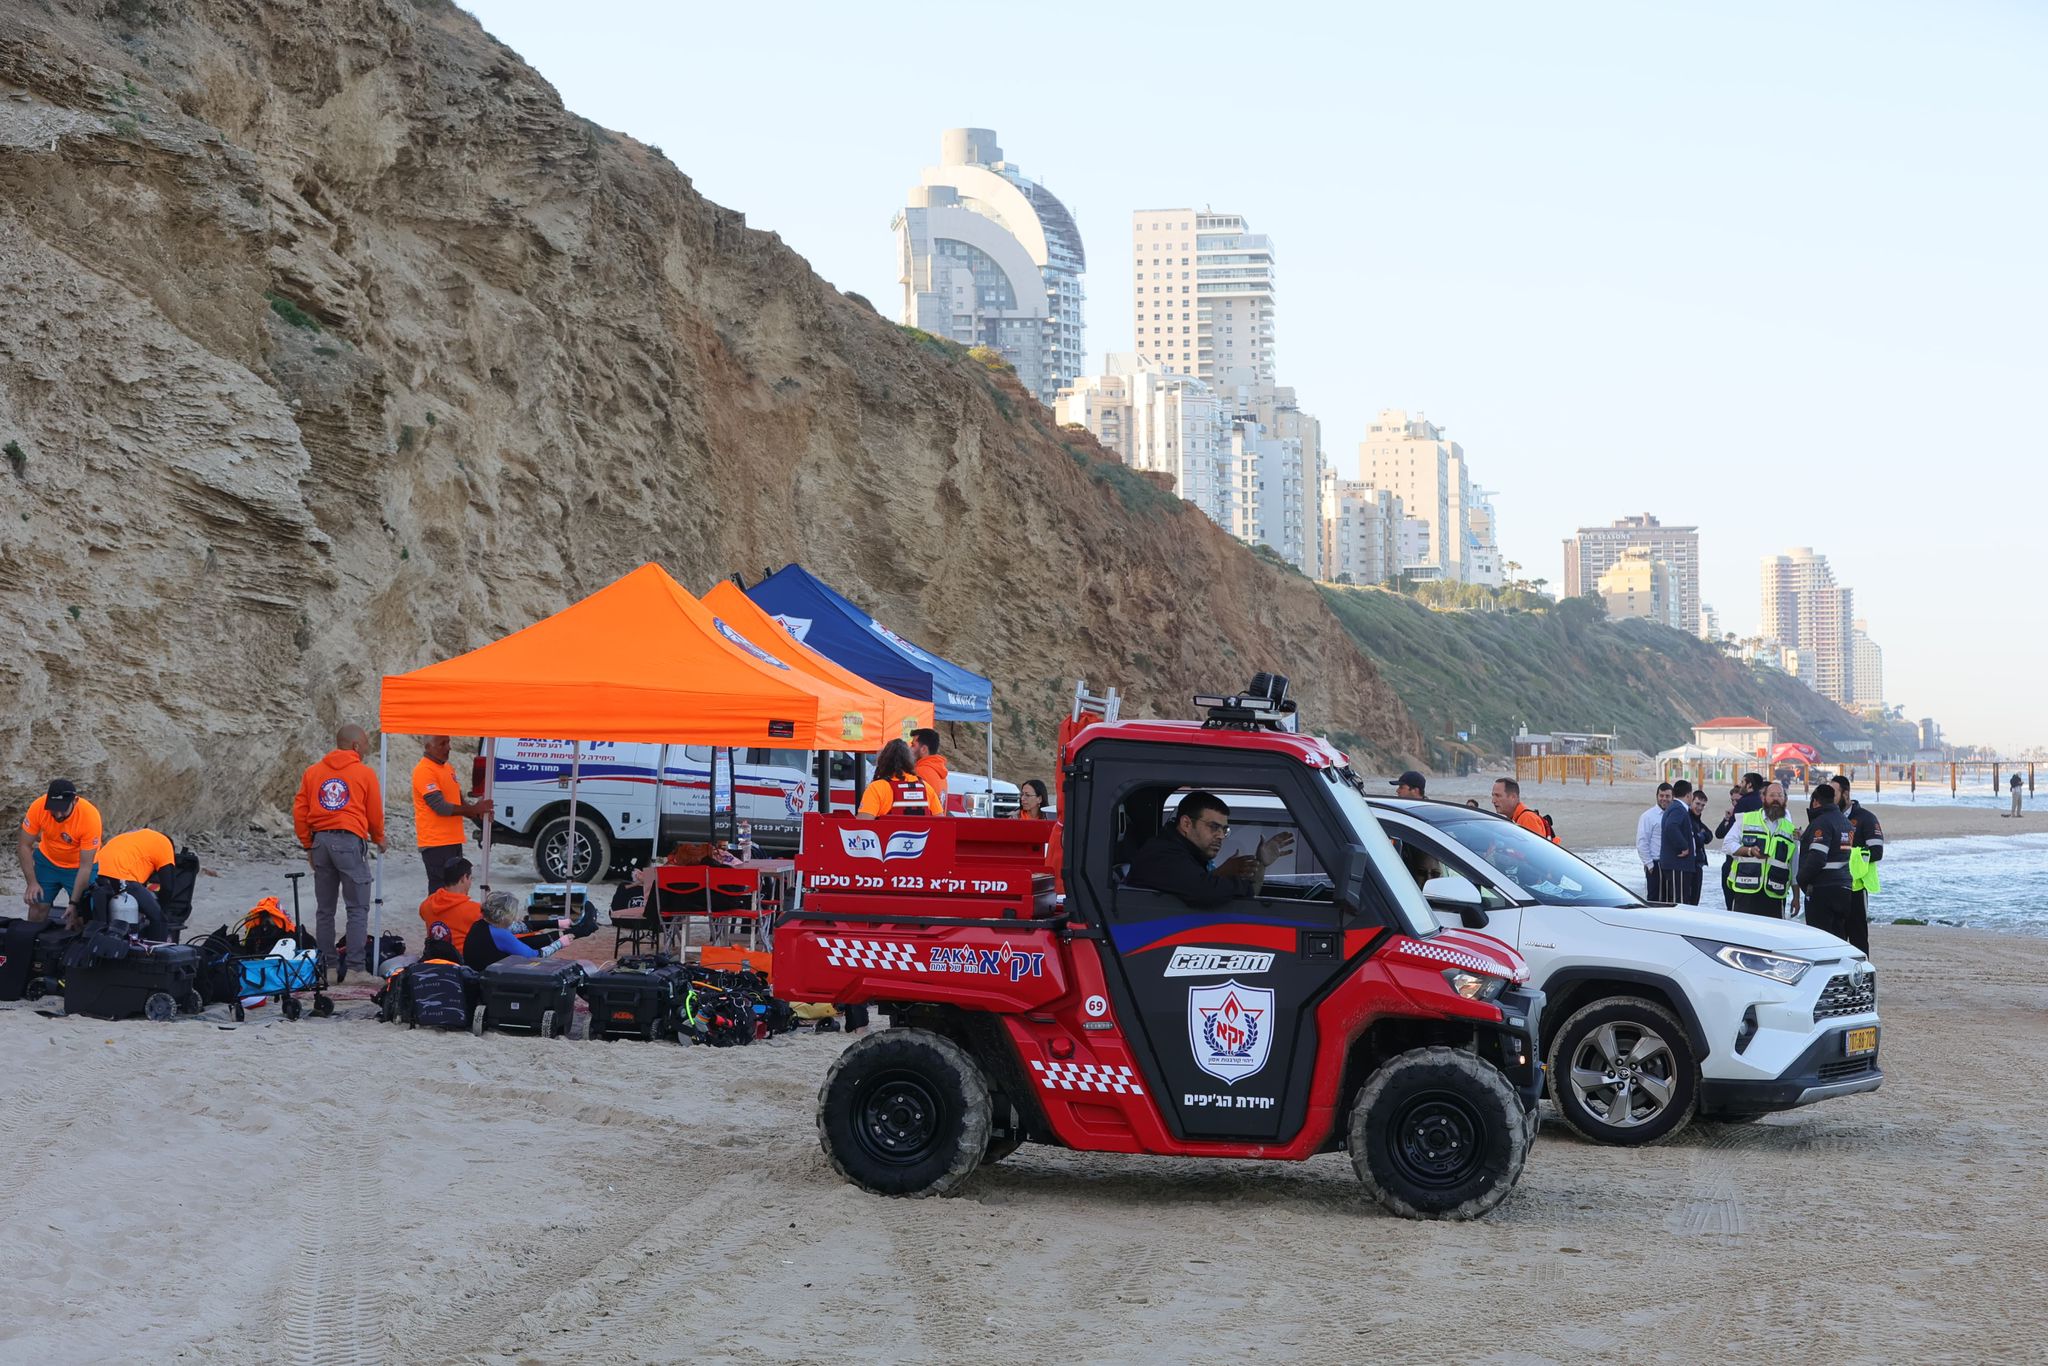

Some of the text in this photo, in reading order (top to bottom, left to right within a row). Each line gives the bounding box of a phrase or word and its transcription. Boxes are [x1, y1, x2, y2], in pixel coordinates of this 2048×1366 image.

[499, 763, 520, 771] אביב
[527, 763, 539, 772] תל
[753, 823, 774, 831] 1223
[809, 873, 851, 888] טלפון
[854, 873, 885, 888] מכל
[890, 876, 925, 889] 1223
[970, 879, 1009, 894] מוקד
[1088, 1000, 1104, 1012] 69
[1216, 1020, 1245, 1051] זקא
[1183, 1093, 1275, 1109] יחידת הג'יפים
